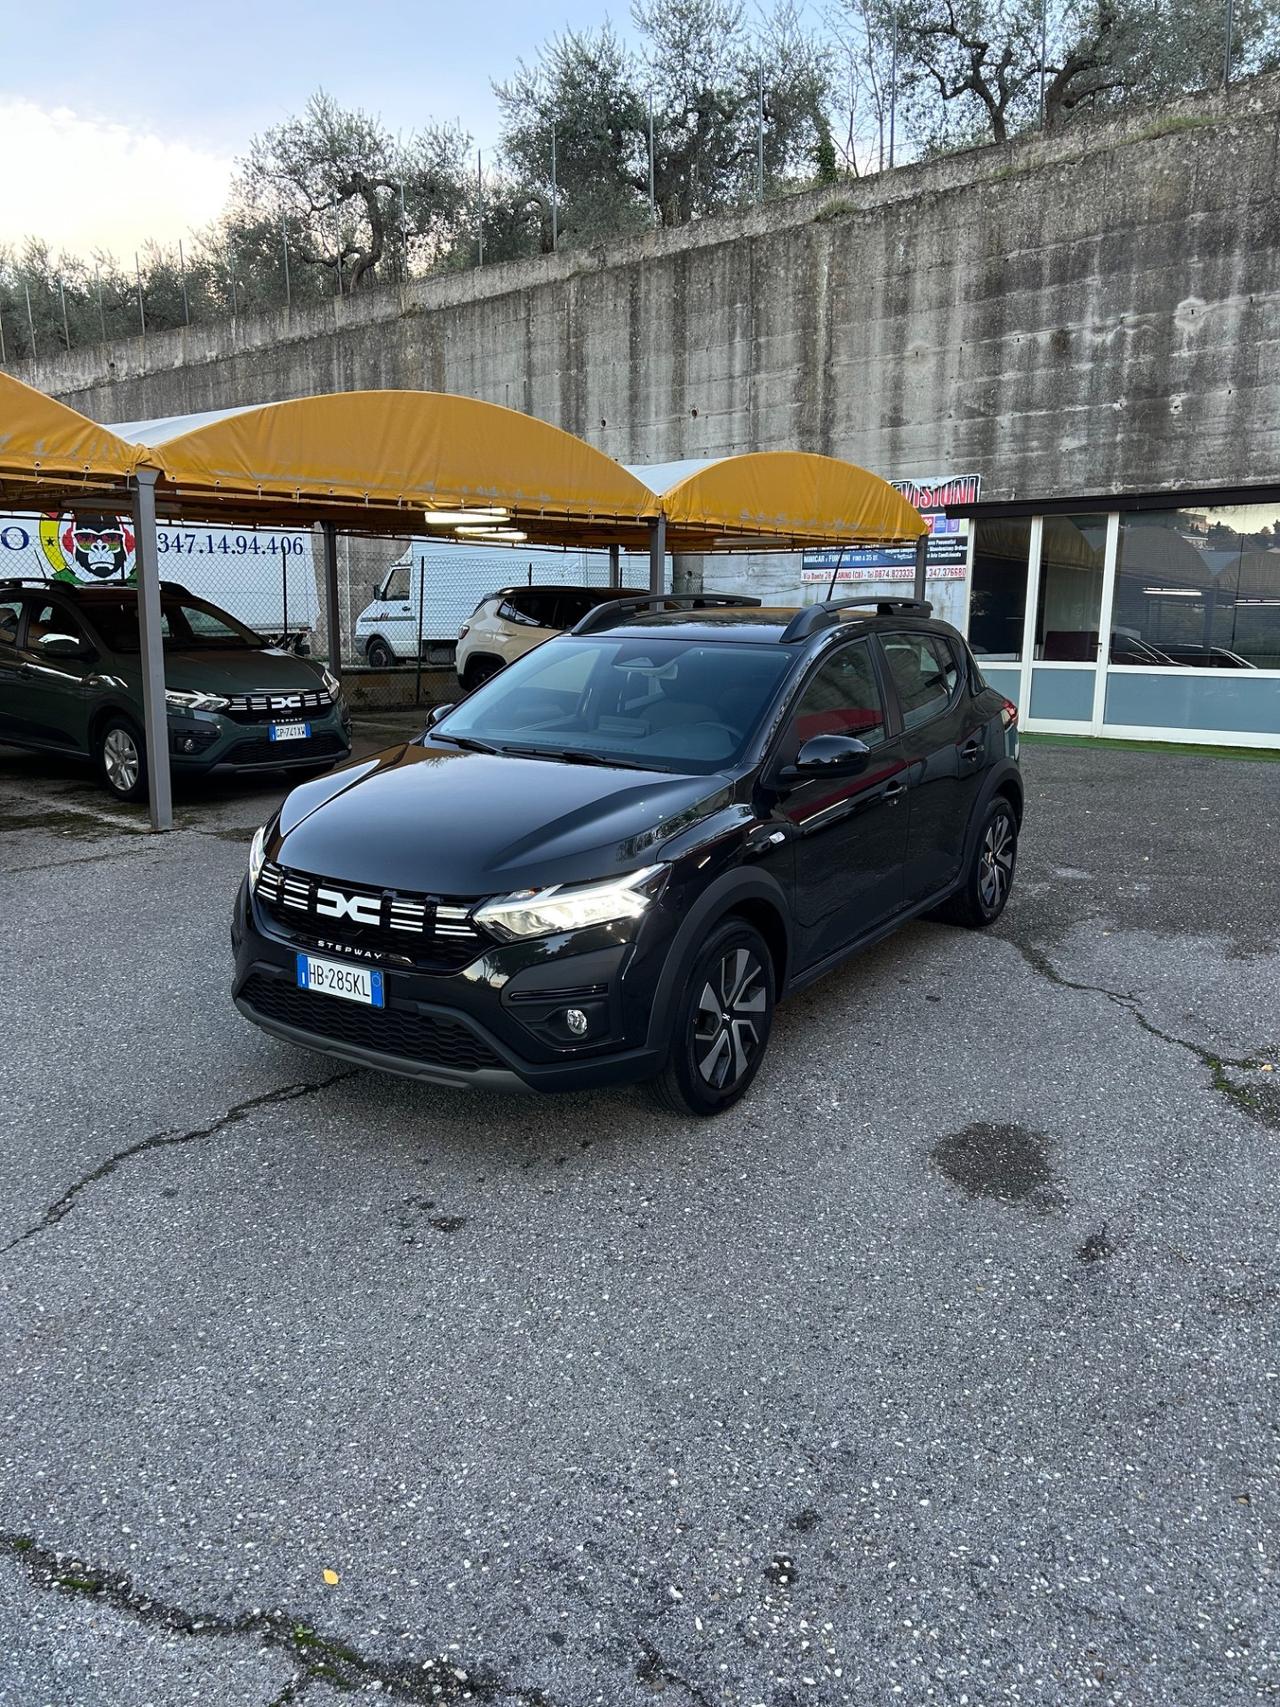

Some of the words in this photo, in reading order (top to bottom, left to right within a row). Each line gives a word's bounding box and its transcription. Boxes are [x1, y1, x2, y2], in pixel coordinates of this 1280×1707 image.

[891, 477, 976, 508] VISIONI
[157, 532, 304, 556] 347.14.94.406
[317, 940, 382, 959] STEPWAY
